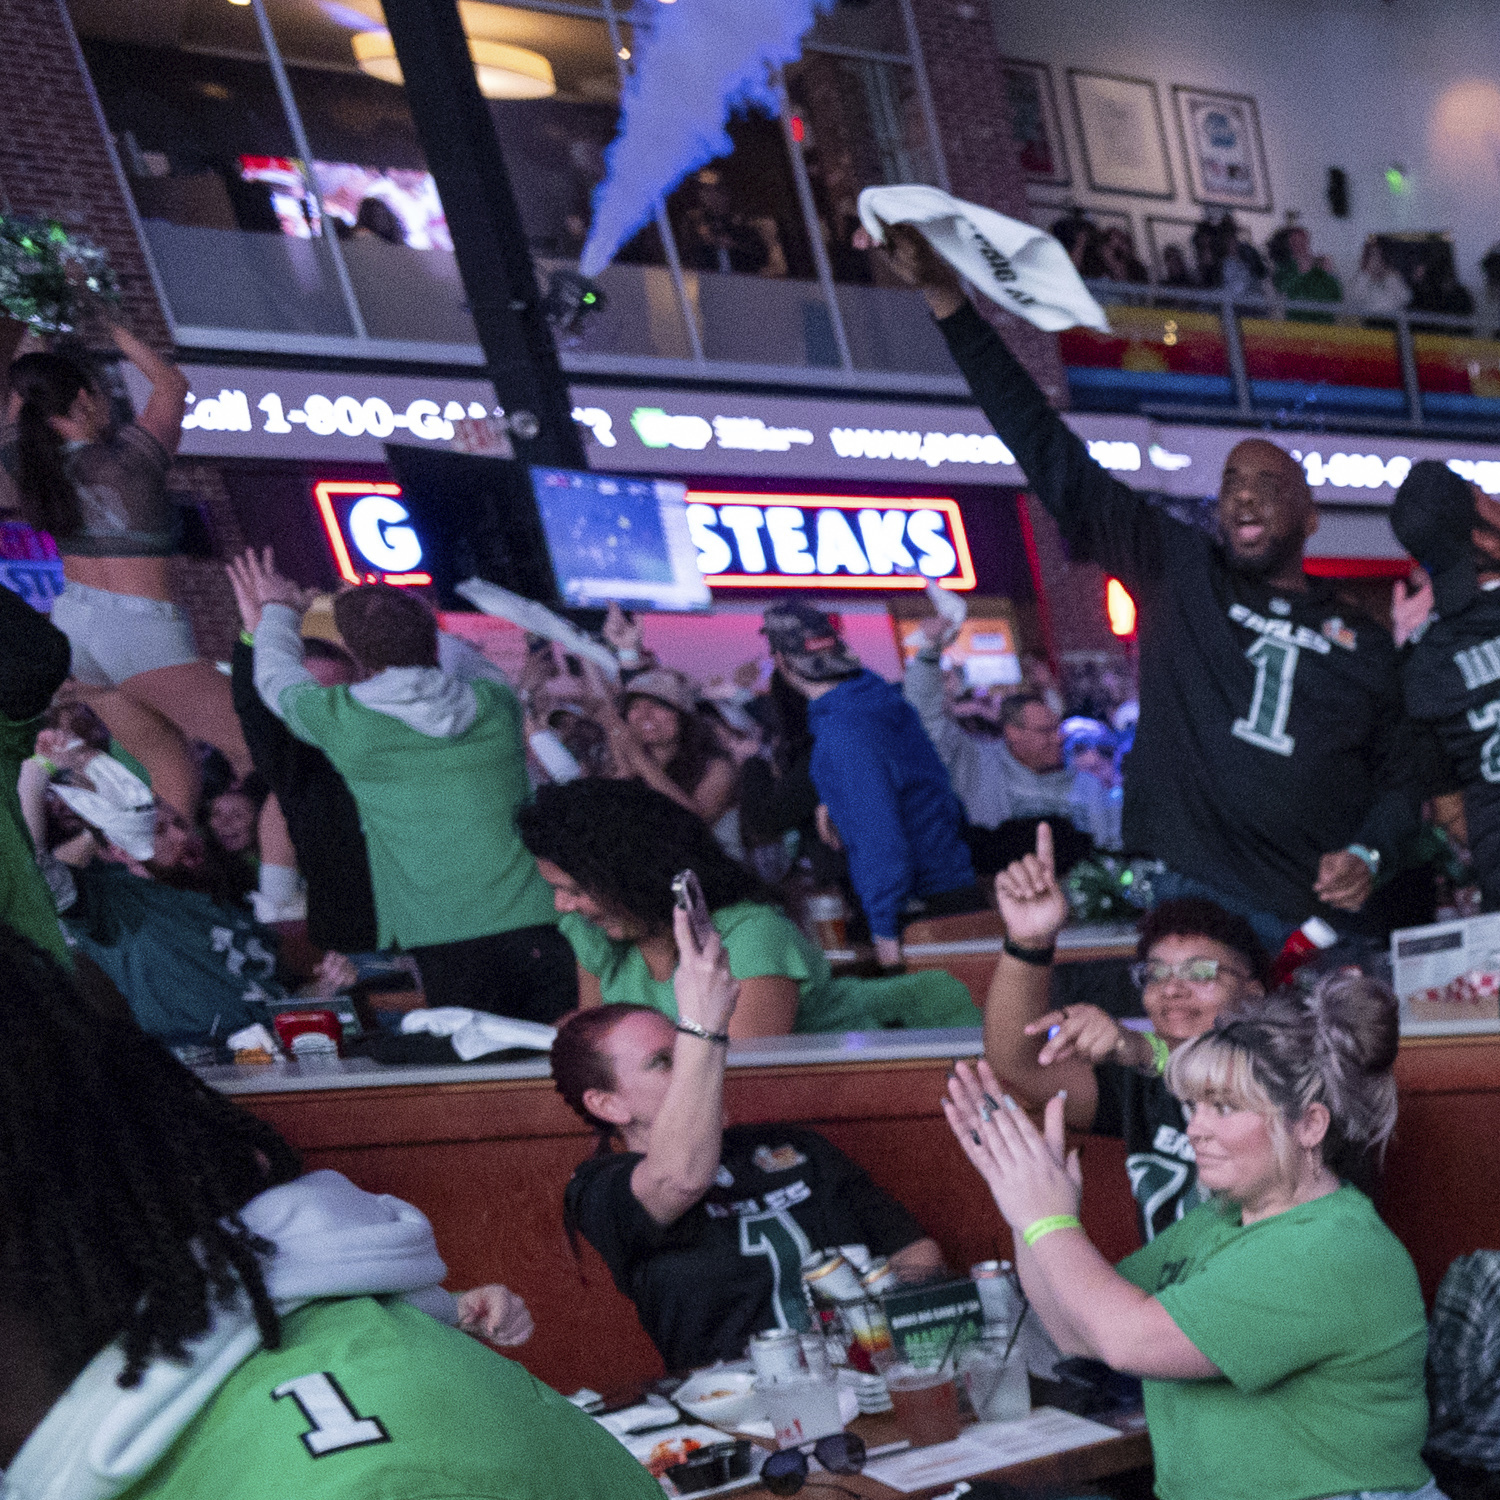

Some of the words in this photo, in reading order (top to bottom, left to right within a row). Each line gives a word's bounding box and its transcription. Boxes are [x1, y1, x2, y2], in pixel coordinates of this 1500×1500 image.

[685, 503, 957, 577] STEAKS
[1231, 632, 1300, 757] 1
[269, 1370, 392, 1459] 1
